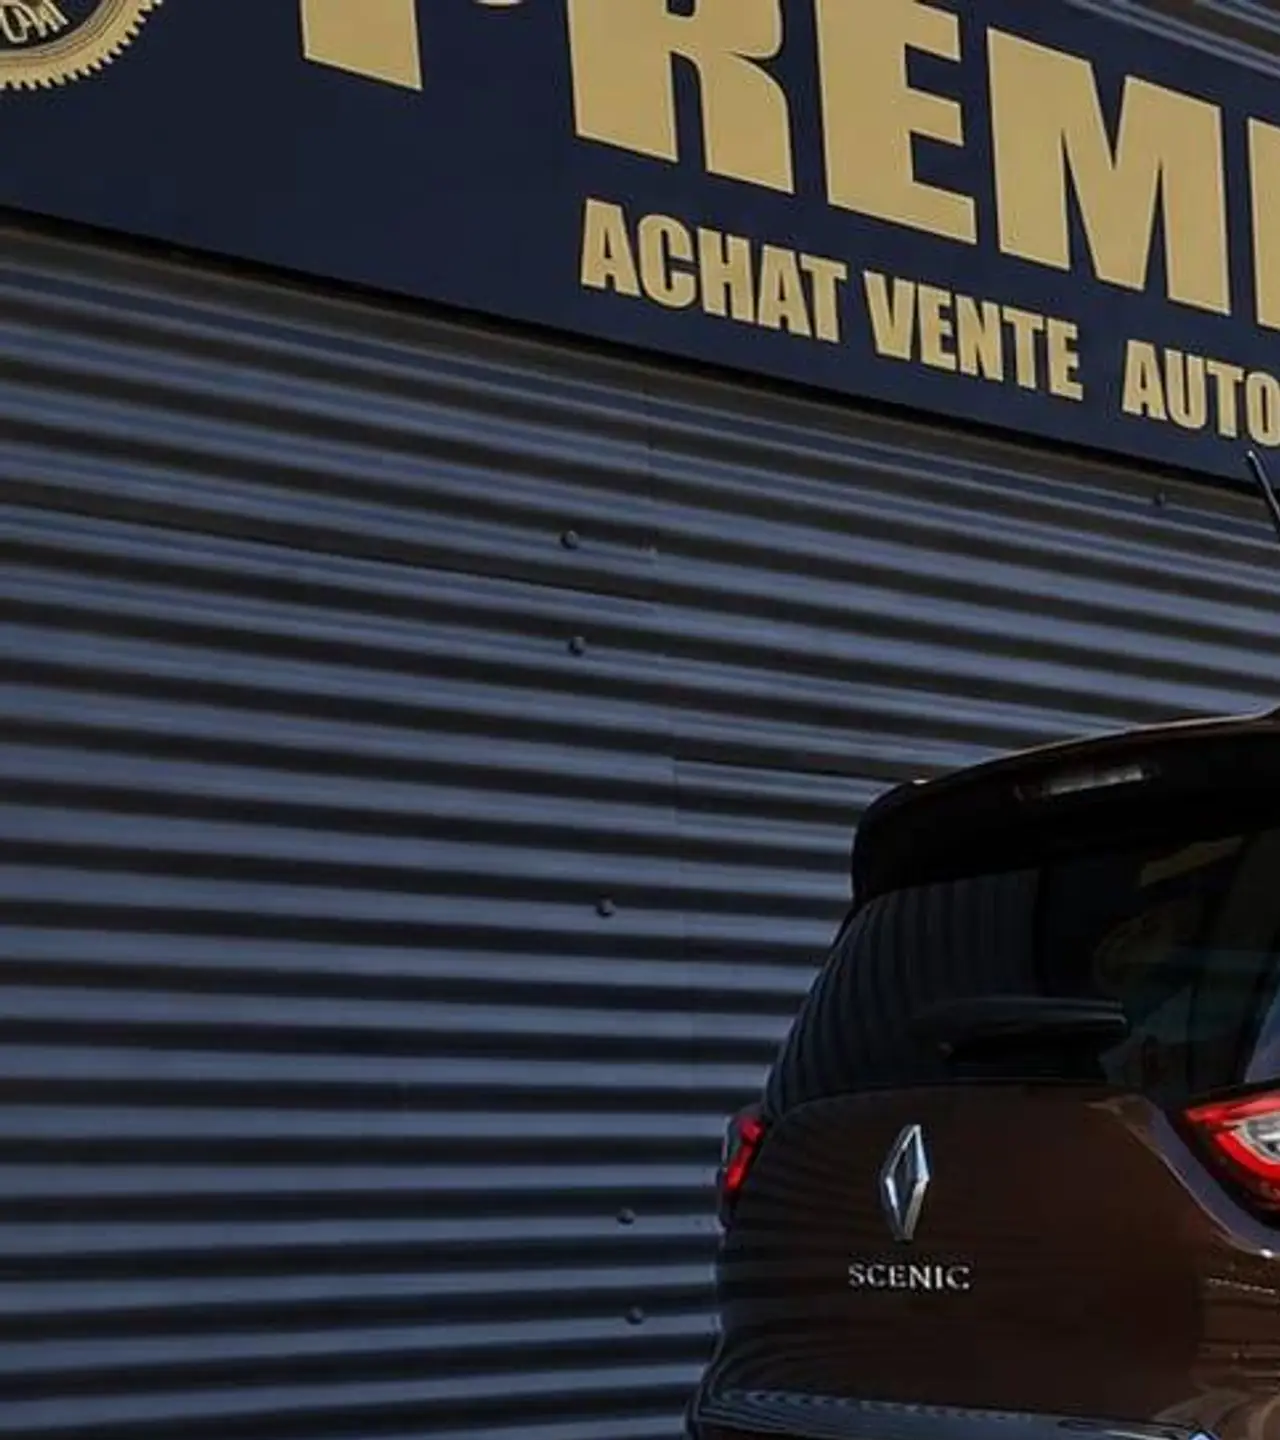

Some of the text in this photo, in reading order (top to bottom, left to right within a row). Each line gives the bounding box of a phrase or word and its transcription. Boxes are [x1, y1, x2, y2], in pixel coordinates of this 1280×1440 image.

[581, 198, 848, 343] ACHAT
[863, 270, 1084, 401] VENTE
[848, 1262, 971, 1291] SCENIC
